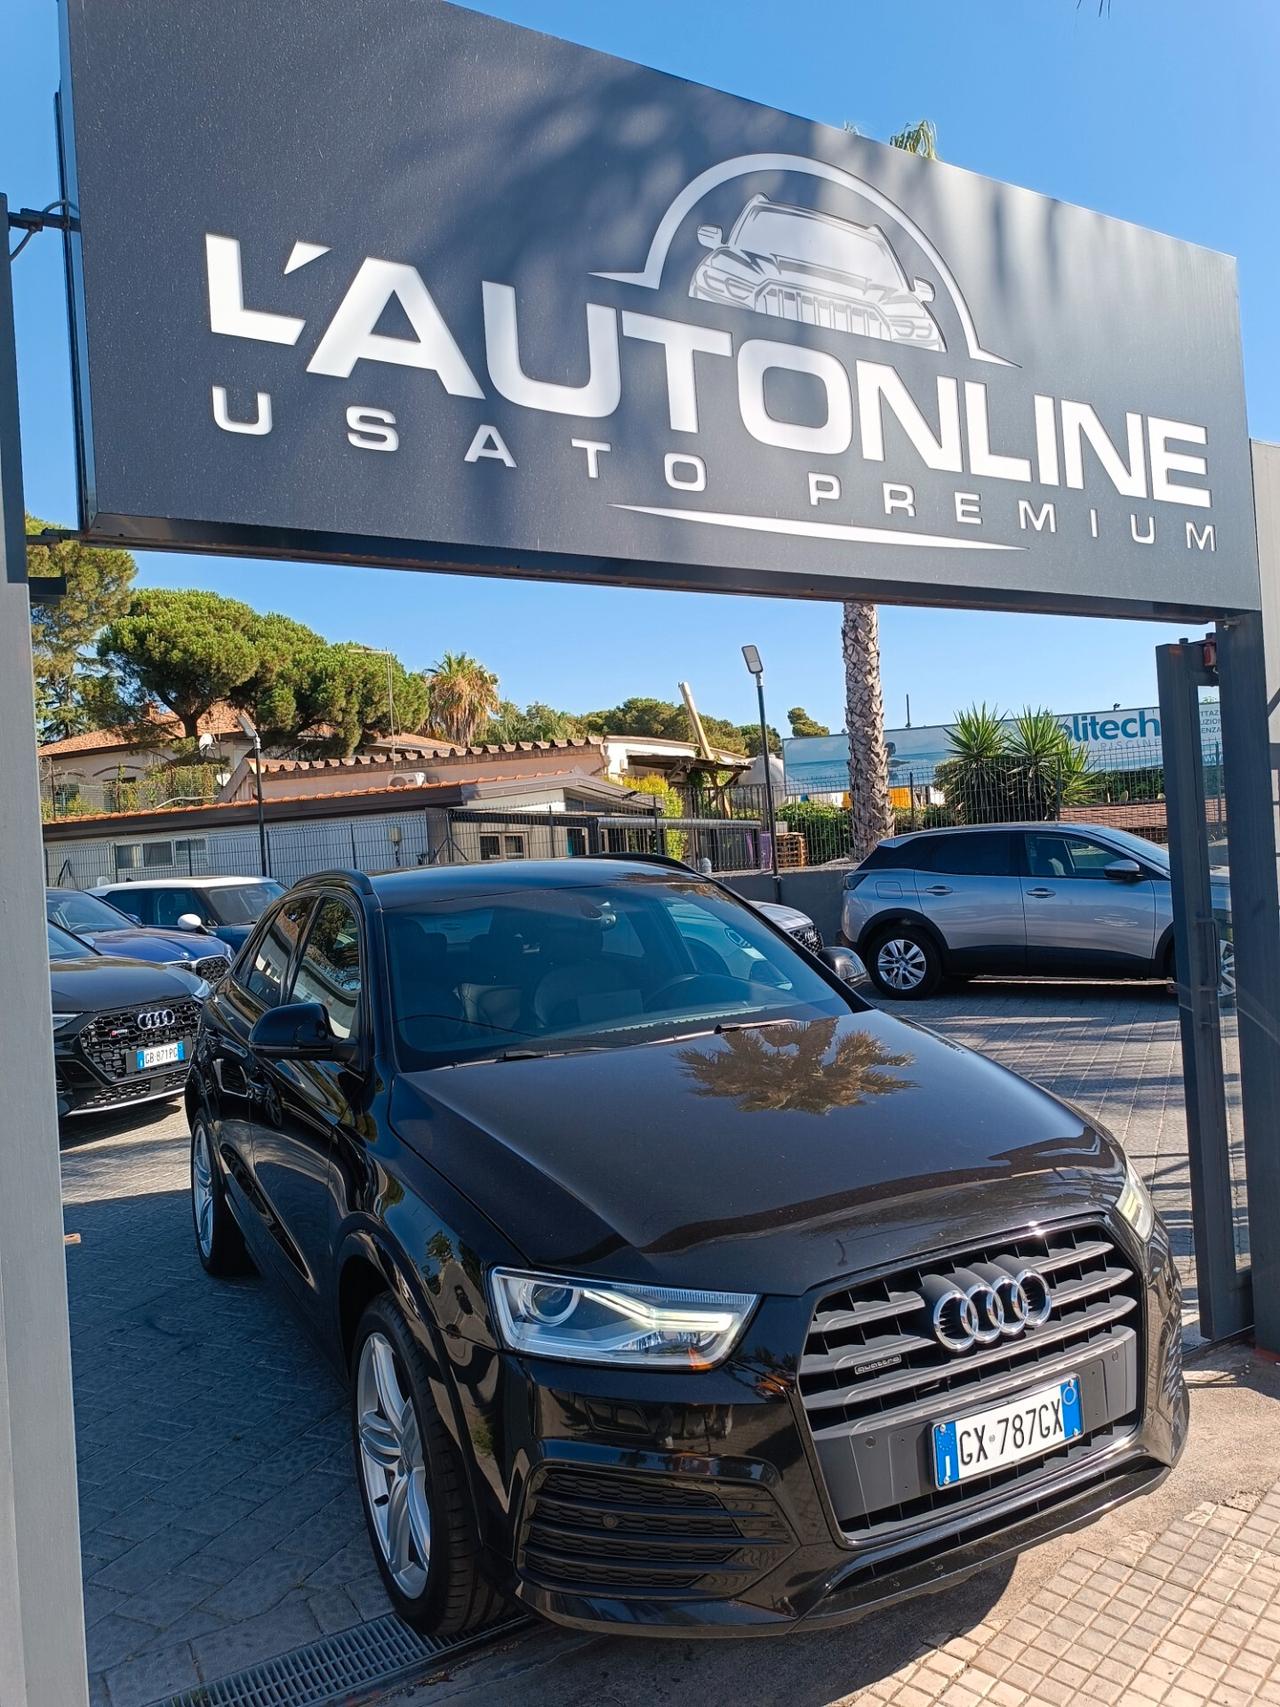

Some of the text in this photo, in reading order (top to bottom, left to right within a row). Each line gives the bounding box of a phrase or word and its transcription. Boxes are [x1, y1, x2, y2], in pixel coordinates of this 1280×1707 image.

[205, 232, 1212, 509] L'AUTONLINE
[211, 385, 1218, 553] USATO PREMIUM
[959, 1424, 989, 1466] GX
[997, 1398, 1063, 1456] 787GX
